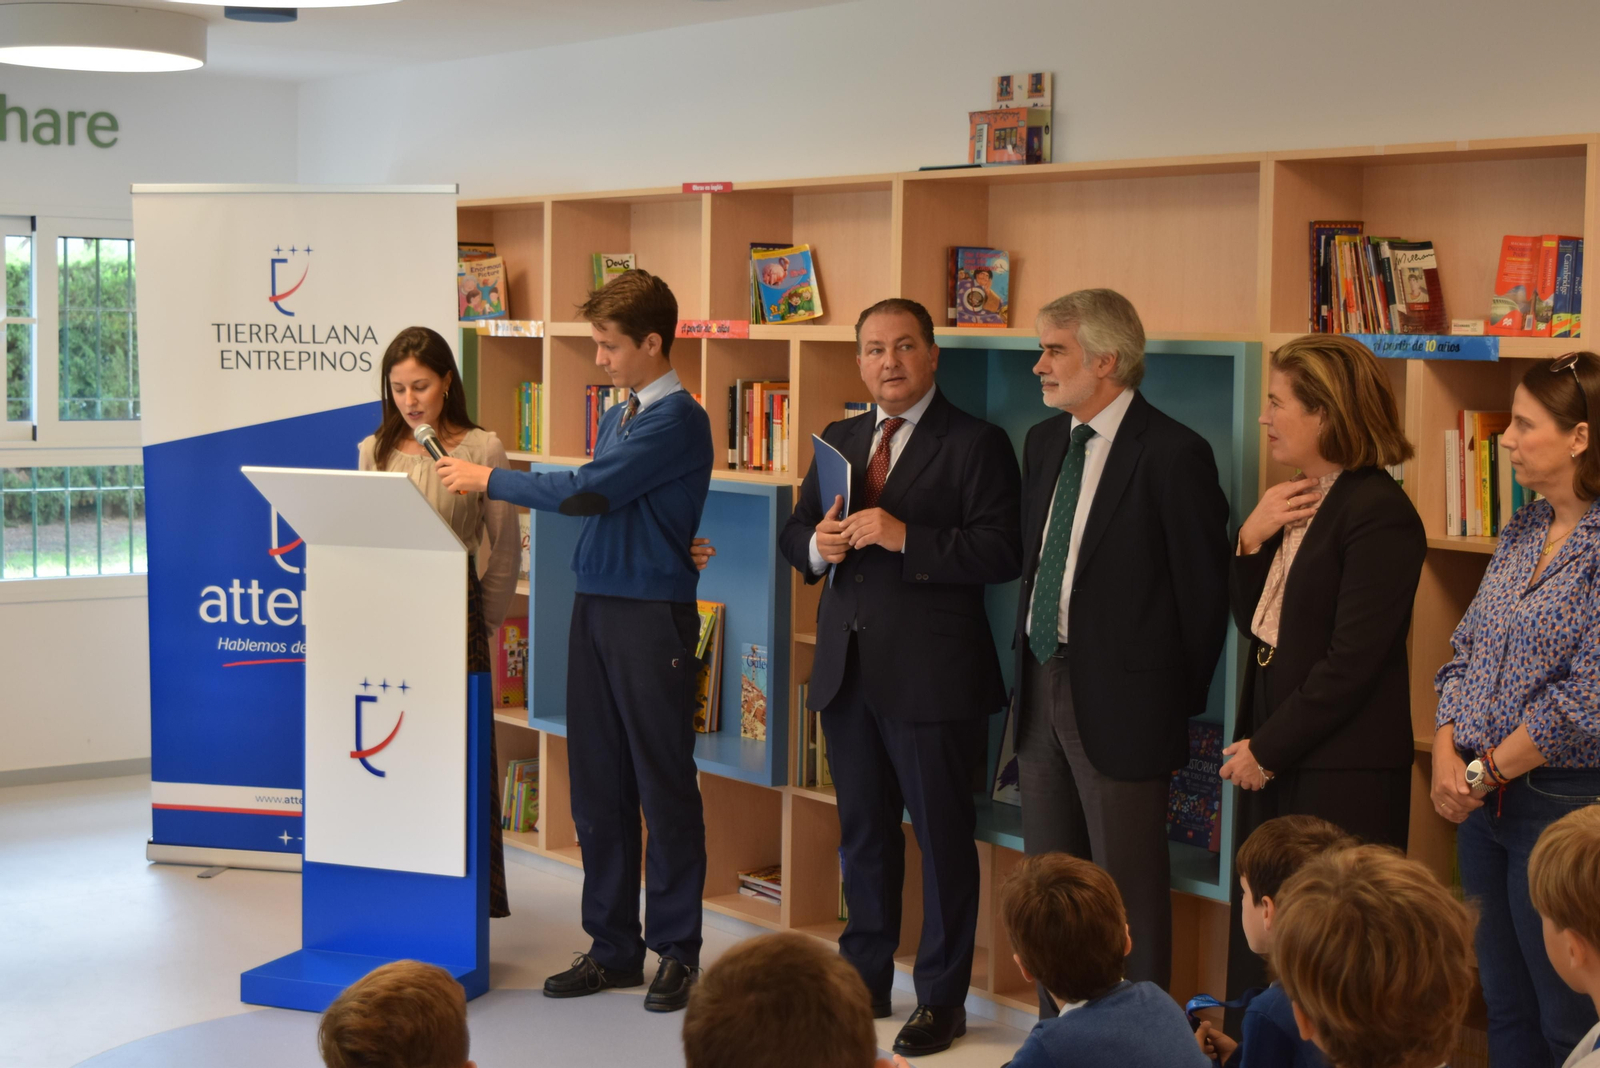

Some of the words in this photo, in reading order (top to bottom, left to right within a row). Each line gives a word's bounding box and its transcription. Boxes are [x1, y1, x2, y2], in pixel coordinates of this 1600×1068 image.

[478, 270, 500, 278] Picture
[1561, 253, 1573, 296] Cambridge
[211, 323, 379, 345] TIERRALLANA
[704, 324, 711, 333] de
[711, 322, 717, 333] 8
[717, 324, 730, 333] años
[1382, 341, 1410, 354] partir
[1412, 341, 1423, 352] de
[1425, 340, 1436, 352] 10
[1437, 341, 1461, 352] años
[220, 350, 372, 372] ENTREPINOS
[199, 579, 306, 626] atte
[218, 637, 287, 653] Hablemos
[291, 641, 306, 653] de
[746, 653, 767, 670] Gale
[1186, 758, 1218, 775] ISTORIAS
